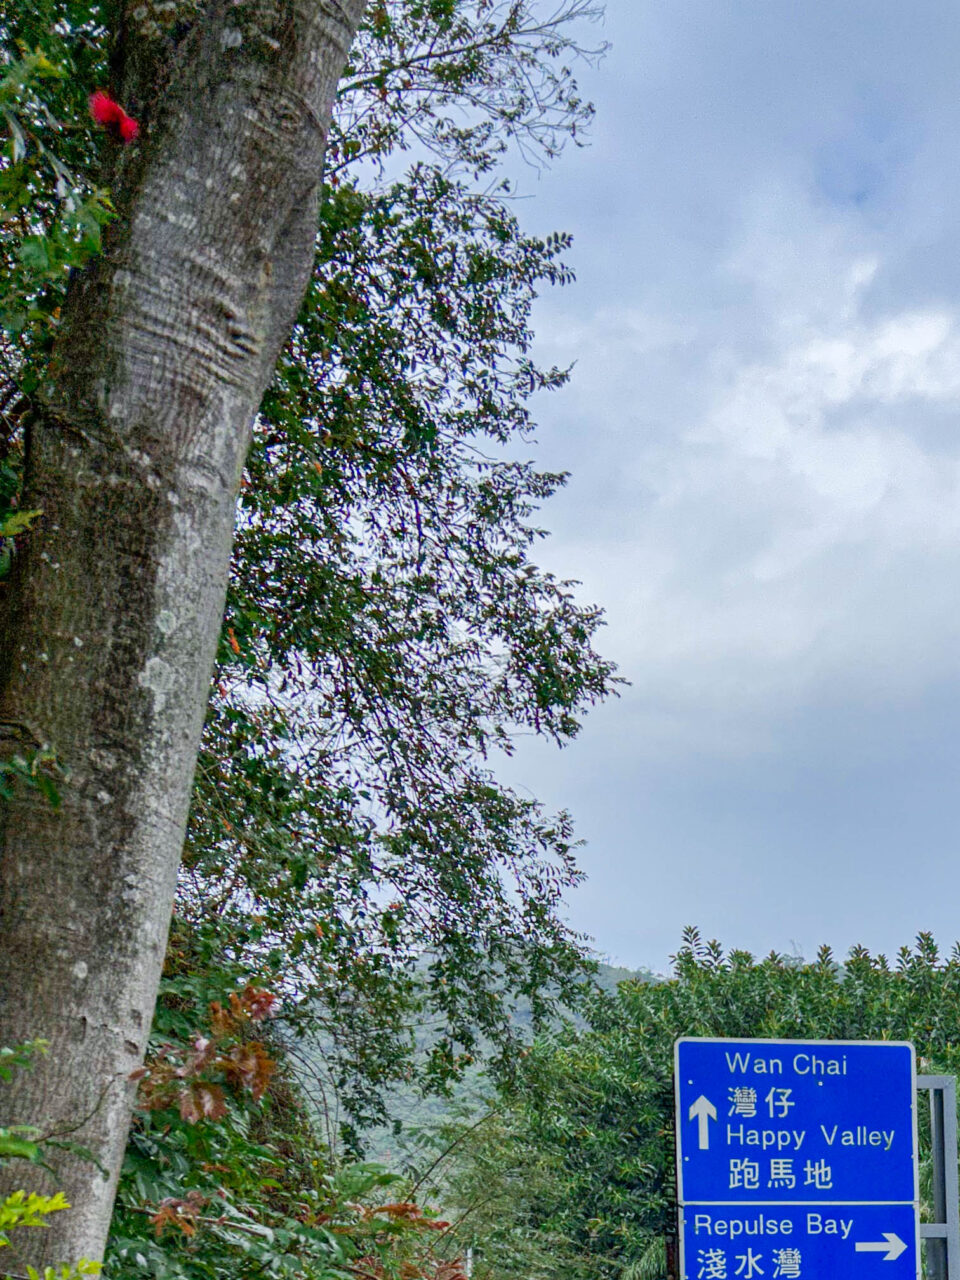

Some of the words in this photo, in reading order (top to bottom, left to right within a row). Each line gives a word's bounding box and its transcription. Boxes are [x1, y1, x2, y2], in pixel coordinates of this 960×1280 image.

[725, 1051, 783, 1074] Wan
[793, 1053, 848, 1076] Chai
[727, 1086, 796, 1119] 灣仔
[726, 1124, 807, 1151] Happy
[820, 1125, 896, 1152] Valley
[728, 1159, 834, 1191] 跑馬地
[694, 1213, 794, 1240] Repulse
[806, 1213, 854, 1240] Bay
[696, 1247, 803, 1280] 淺水灣
